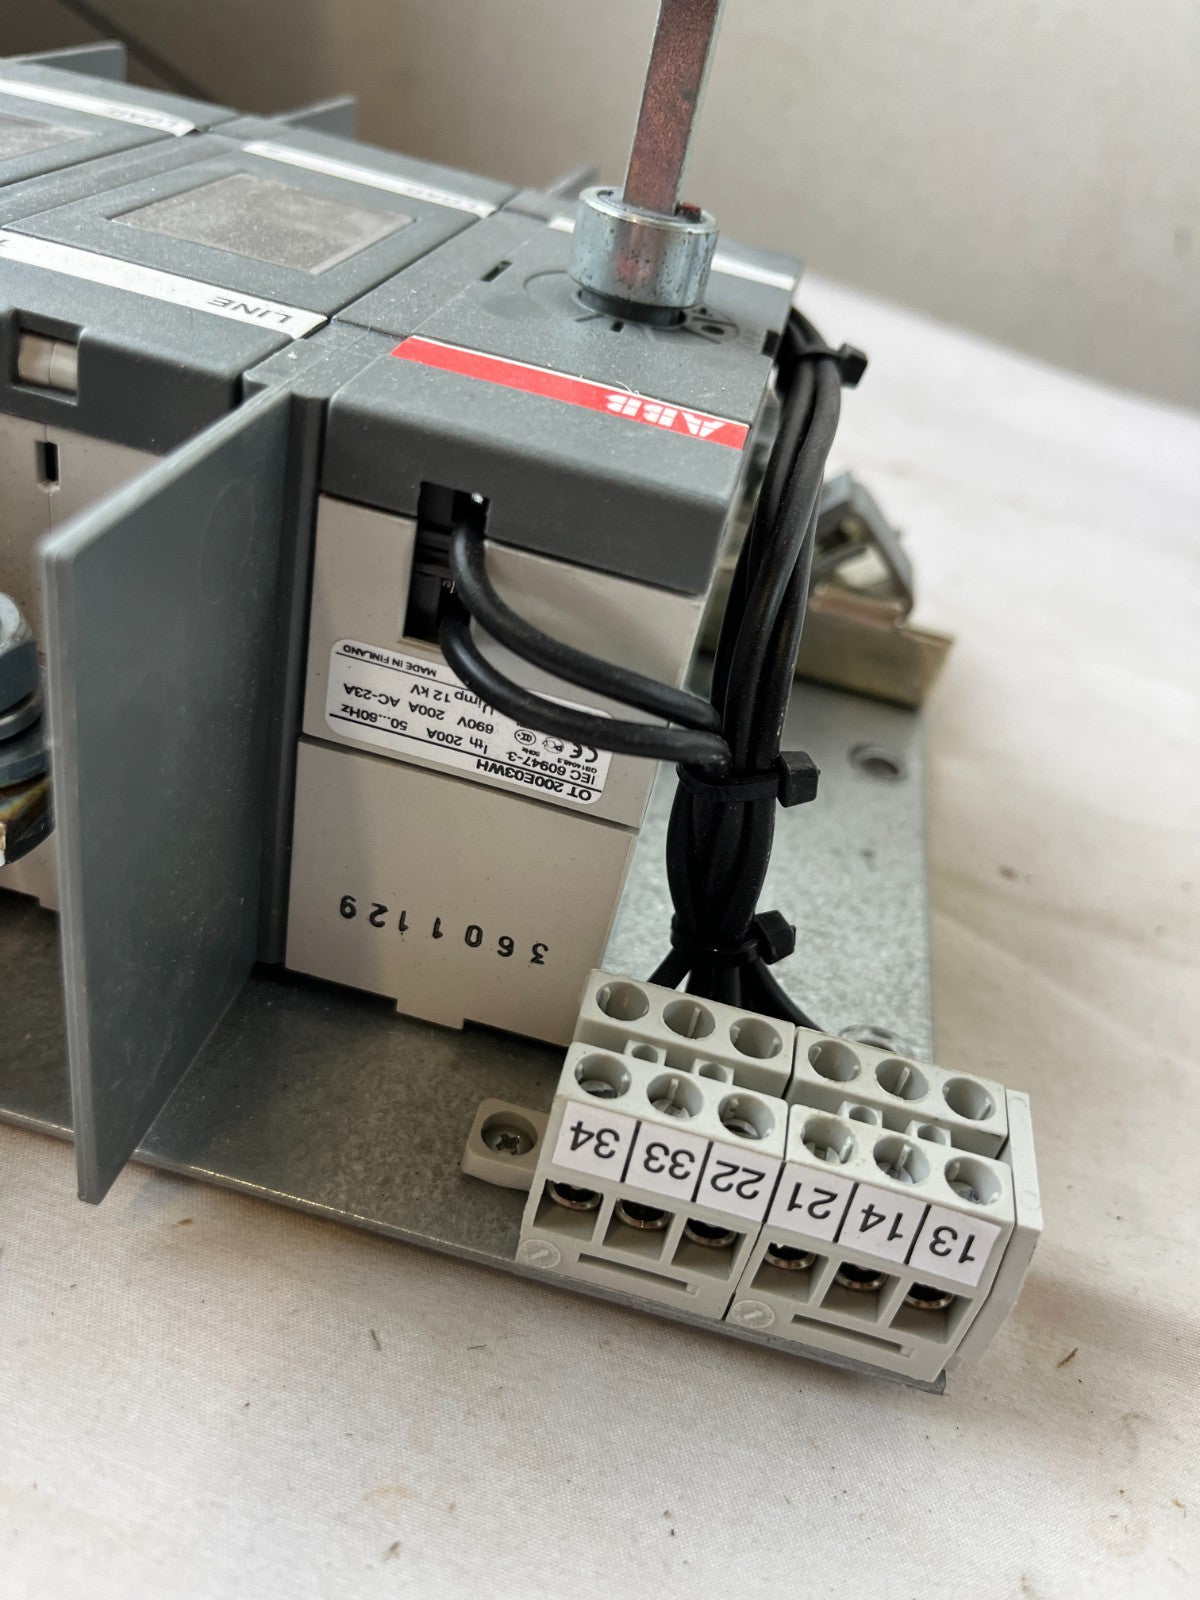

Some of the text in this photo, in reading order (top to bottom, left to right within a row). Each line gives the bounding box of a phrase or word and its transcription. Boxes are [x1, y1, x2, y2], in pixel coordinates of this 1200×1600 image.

[206, 295, 294, 325] LINE
[605, 394, 726, 438] ABB
[343, 644, 437, 678] MADE IN FINLAND
[343, 683, 401, 708] AC-23A
[410, 684, 430, 698] kV
[432, 689, 452, 703] 12
[408, 701, 445, 720] 200A
[426, 727, 463, 746] 200A
[457, 716, 494, 735] 690V
[476, 758, 592, 801] OT 200E03WH
[569, 769, 596, 785] IEC
[568, 1119, 976, 1265] 13 14 21 22 33 34
